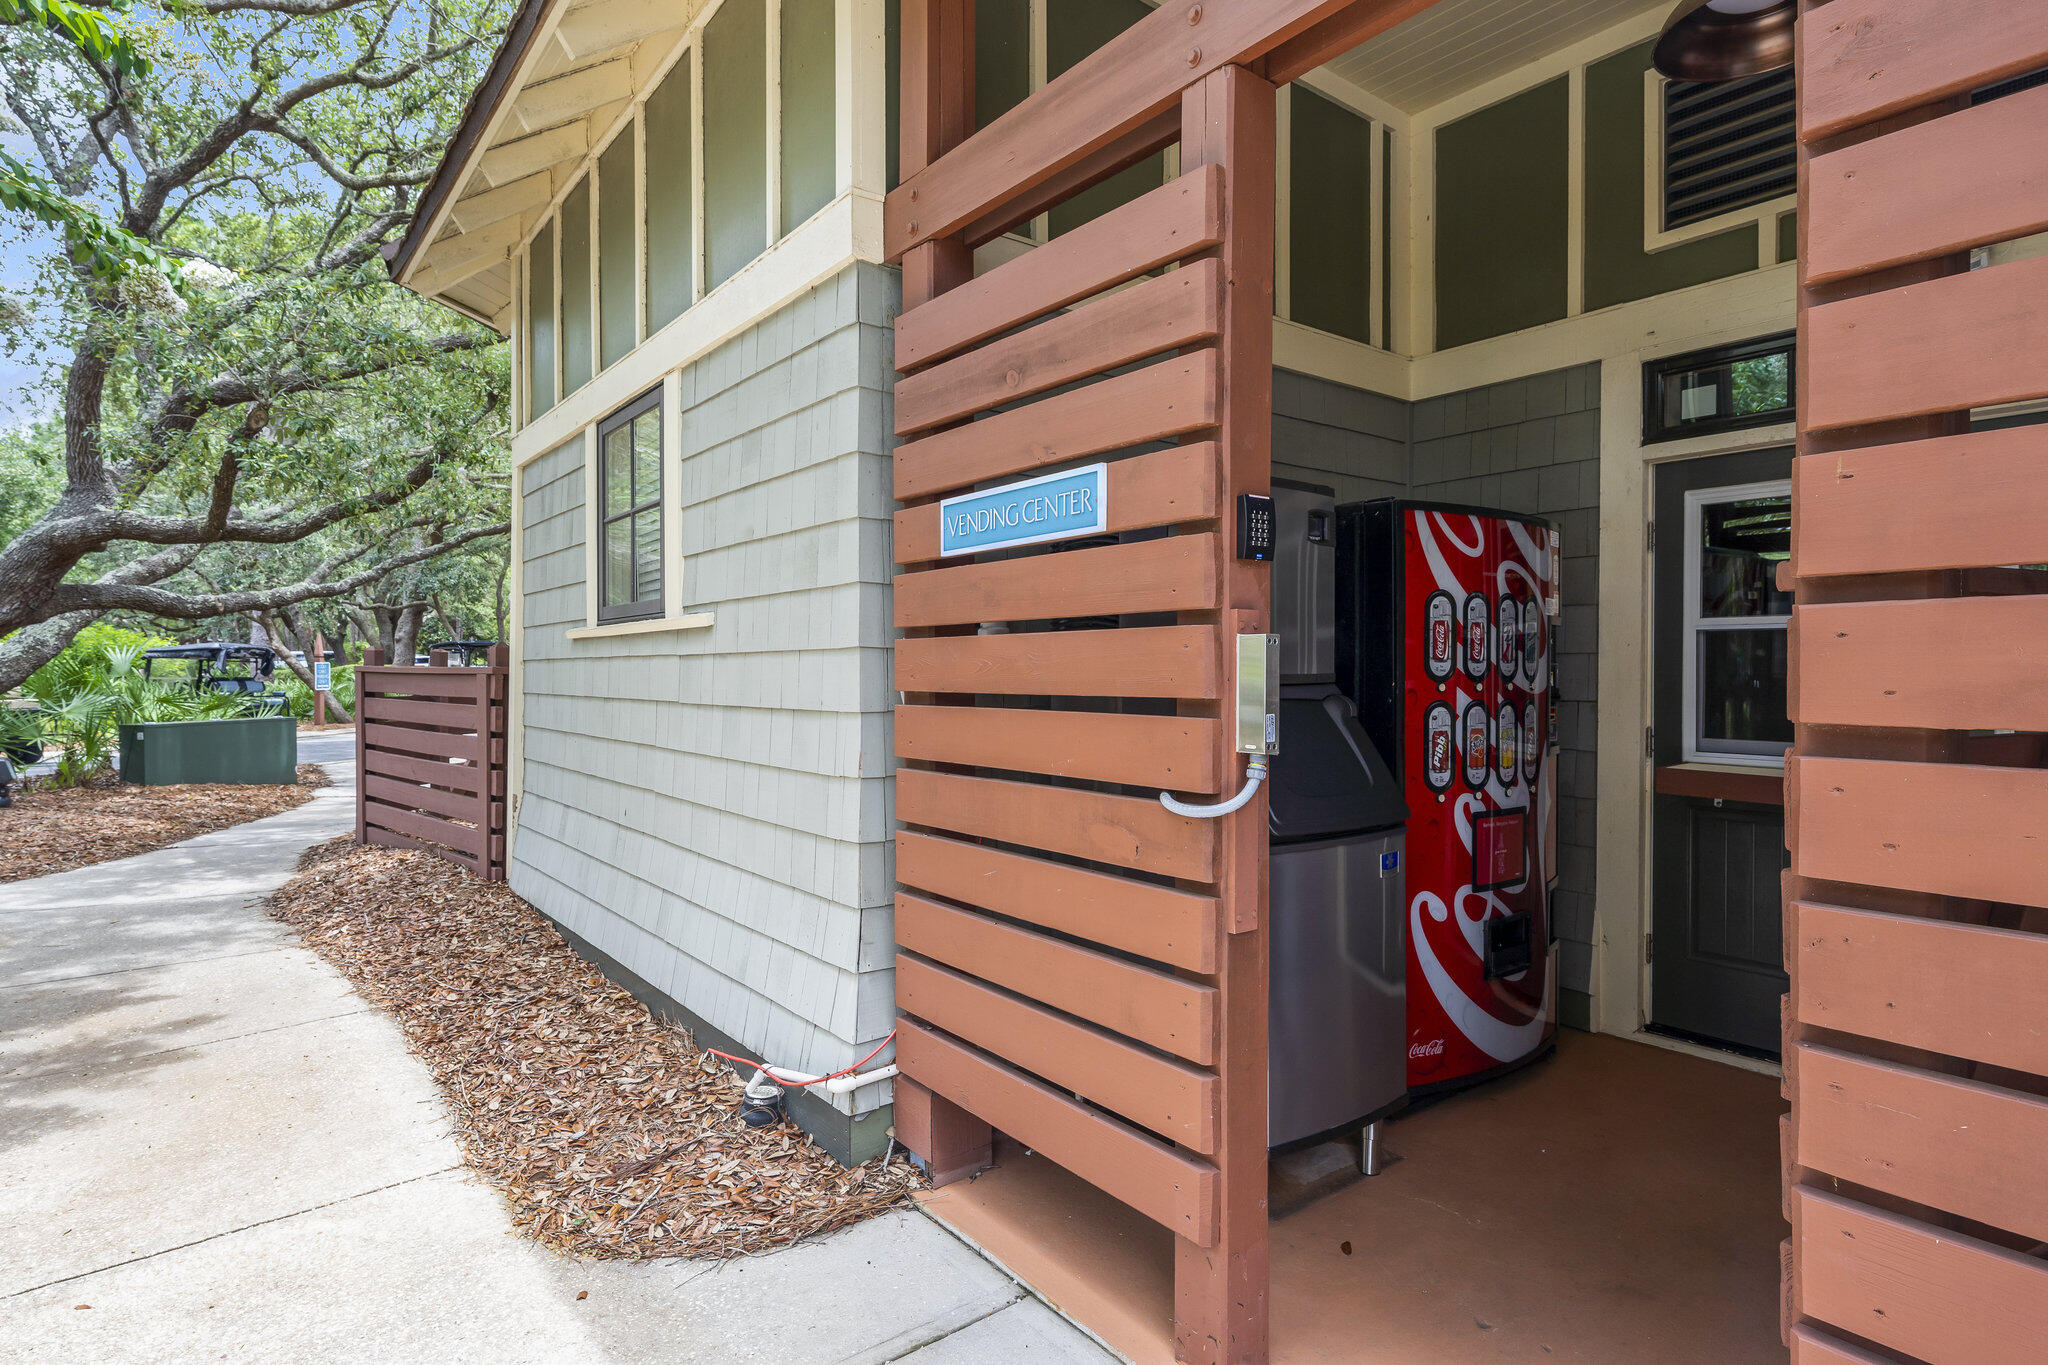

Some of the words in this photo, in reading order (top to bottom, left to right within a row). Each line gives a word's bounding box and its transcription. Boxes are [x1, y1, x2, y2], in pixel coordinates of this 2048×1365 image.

[947, 503, 1019, 537] VENDING
[1022, 488, 1093, 523] CENTER
[1433, 735, 1446, 768] Pibb
